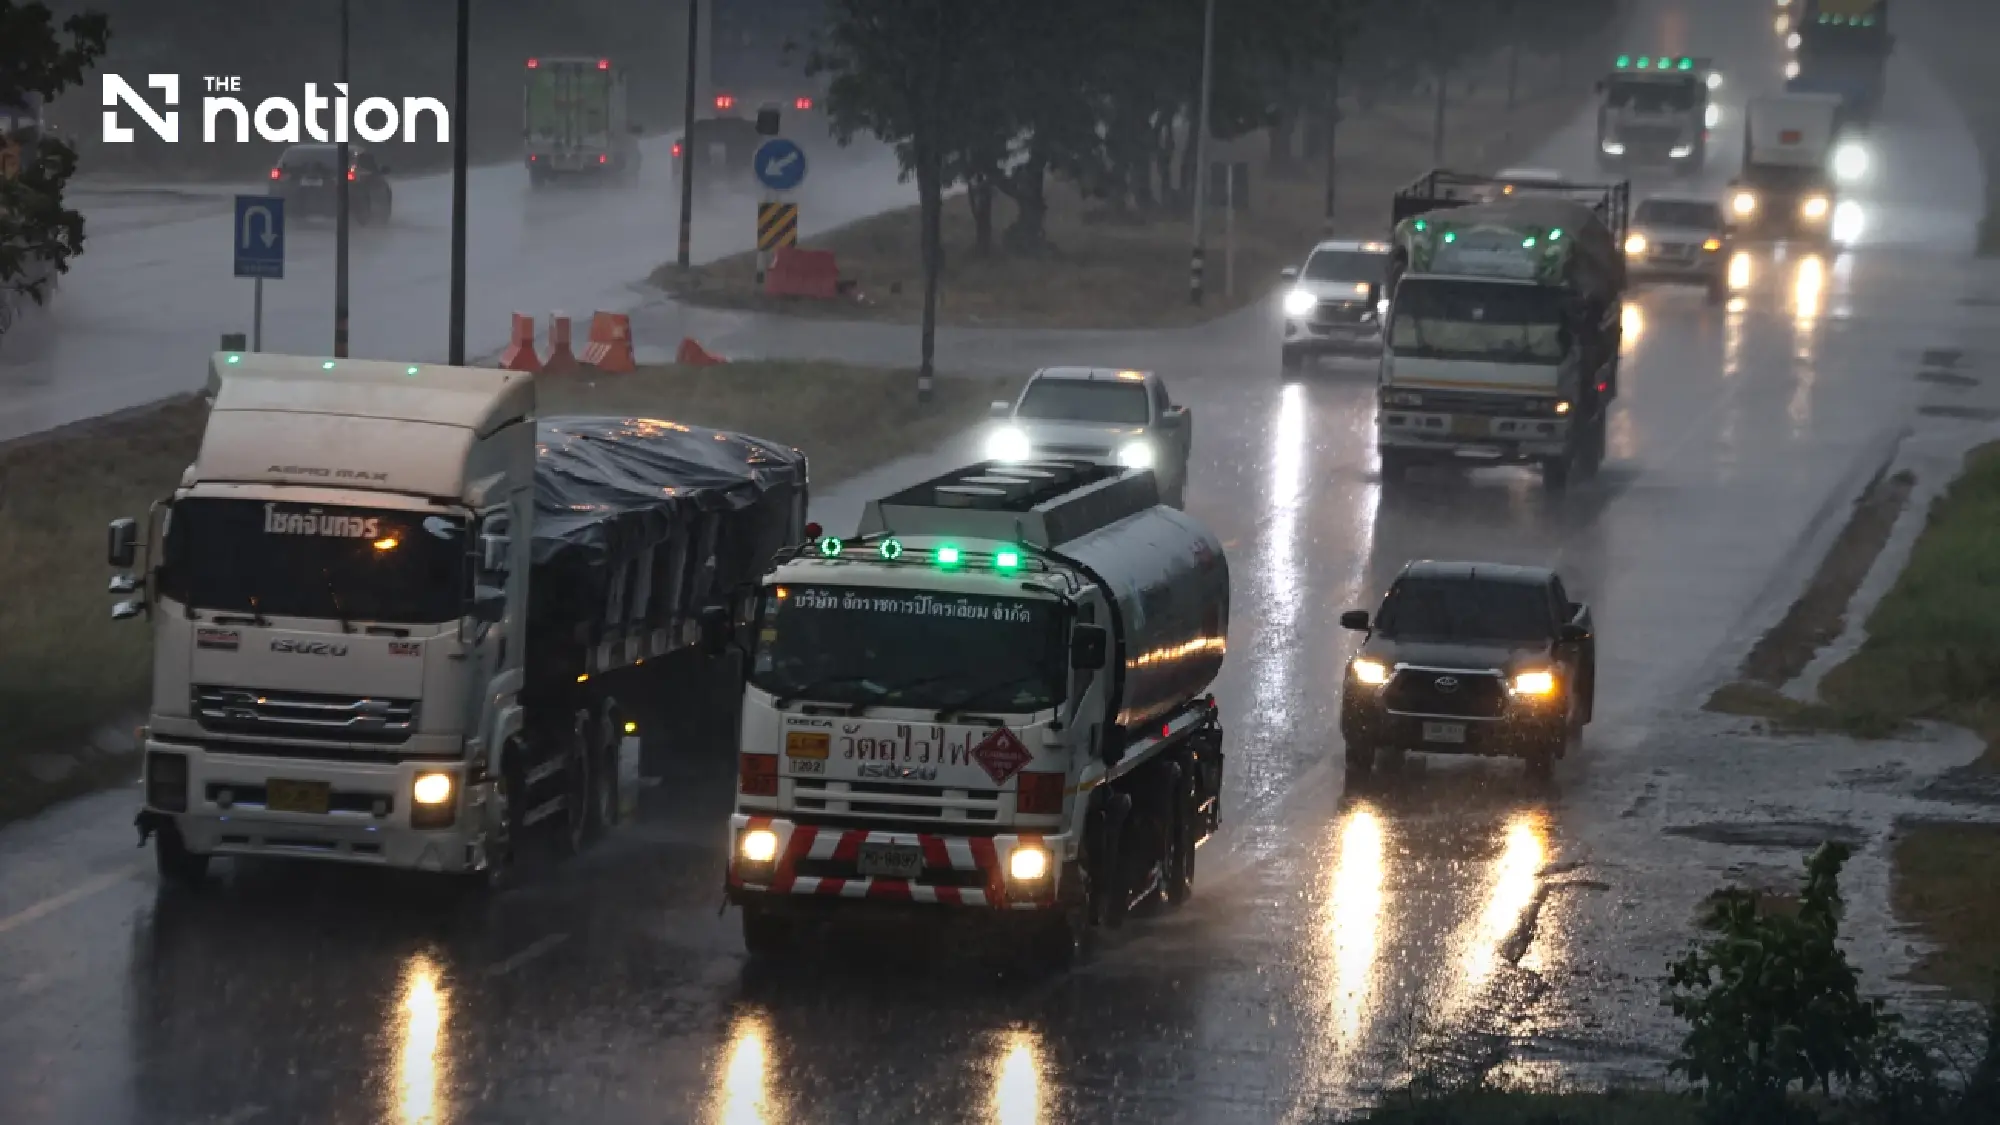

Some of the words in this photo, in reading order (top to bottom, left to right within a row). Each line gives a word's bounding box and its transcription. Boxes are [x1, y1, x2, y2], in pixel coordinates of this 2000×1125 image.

[794, 588, 838, 609] บริษัท
[992, 602, 1031, 623] จำกัด
[271, 638, 349, 657] ISUZU
